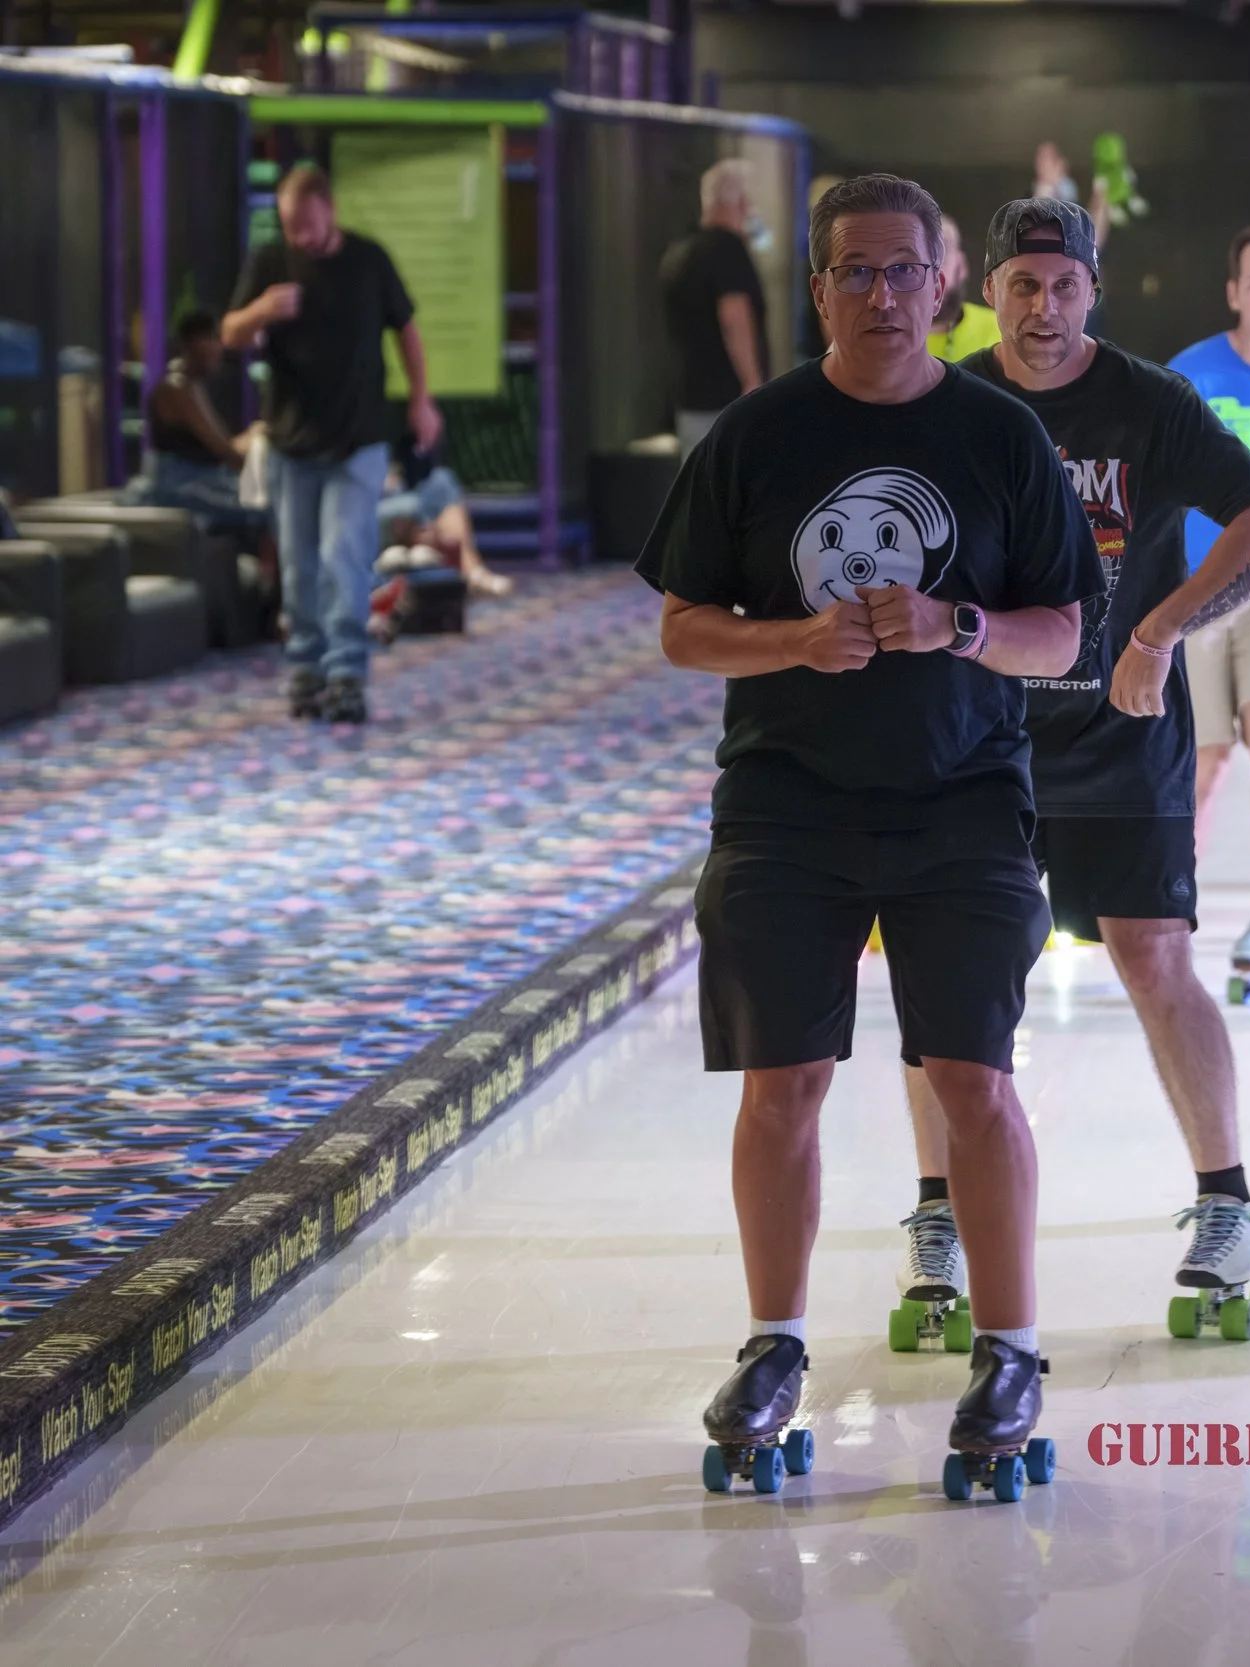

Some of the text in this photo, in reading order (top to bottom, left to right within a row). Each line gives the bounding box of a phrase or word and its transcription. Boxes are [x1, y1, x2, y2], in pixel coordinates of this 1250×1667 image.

[251, 1206, 322, 1301] Watch Your Step!
[152, 1272, 236, 1376] Watch Your Step!
[41, 1347, 135, 1466] Watch Your Step!
